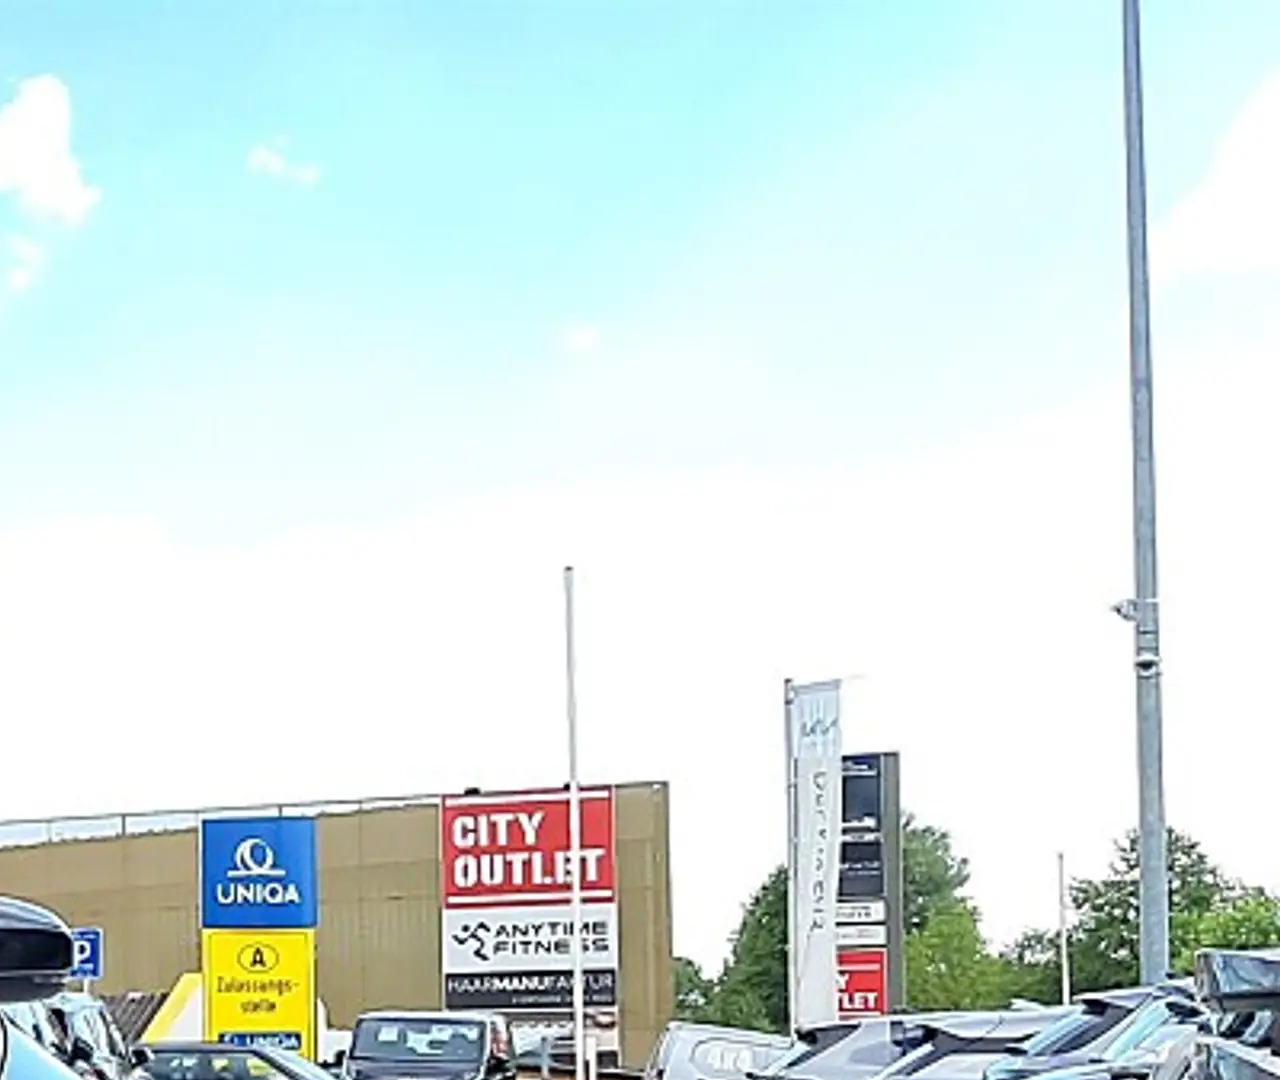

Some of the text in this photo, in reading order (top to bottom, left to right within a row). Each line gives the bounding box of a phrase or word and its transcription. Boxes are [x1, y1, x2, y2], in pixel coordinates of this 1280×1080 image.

[452, 808, 545, 848] CITY
[454, 849, 606, 888] OUTLET
[216, 883, 300, 904] UNIQA
[250, 947, 266, 968] A
[448, 974, 613, 995] HAARMANUFATUR
